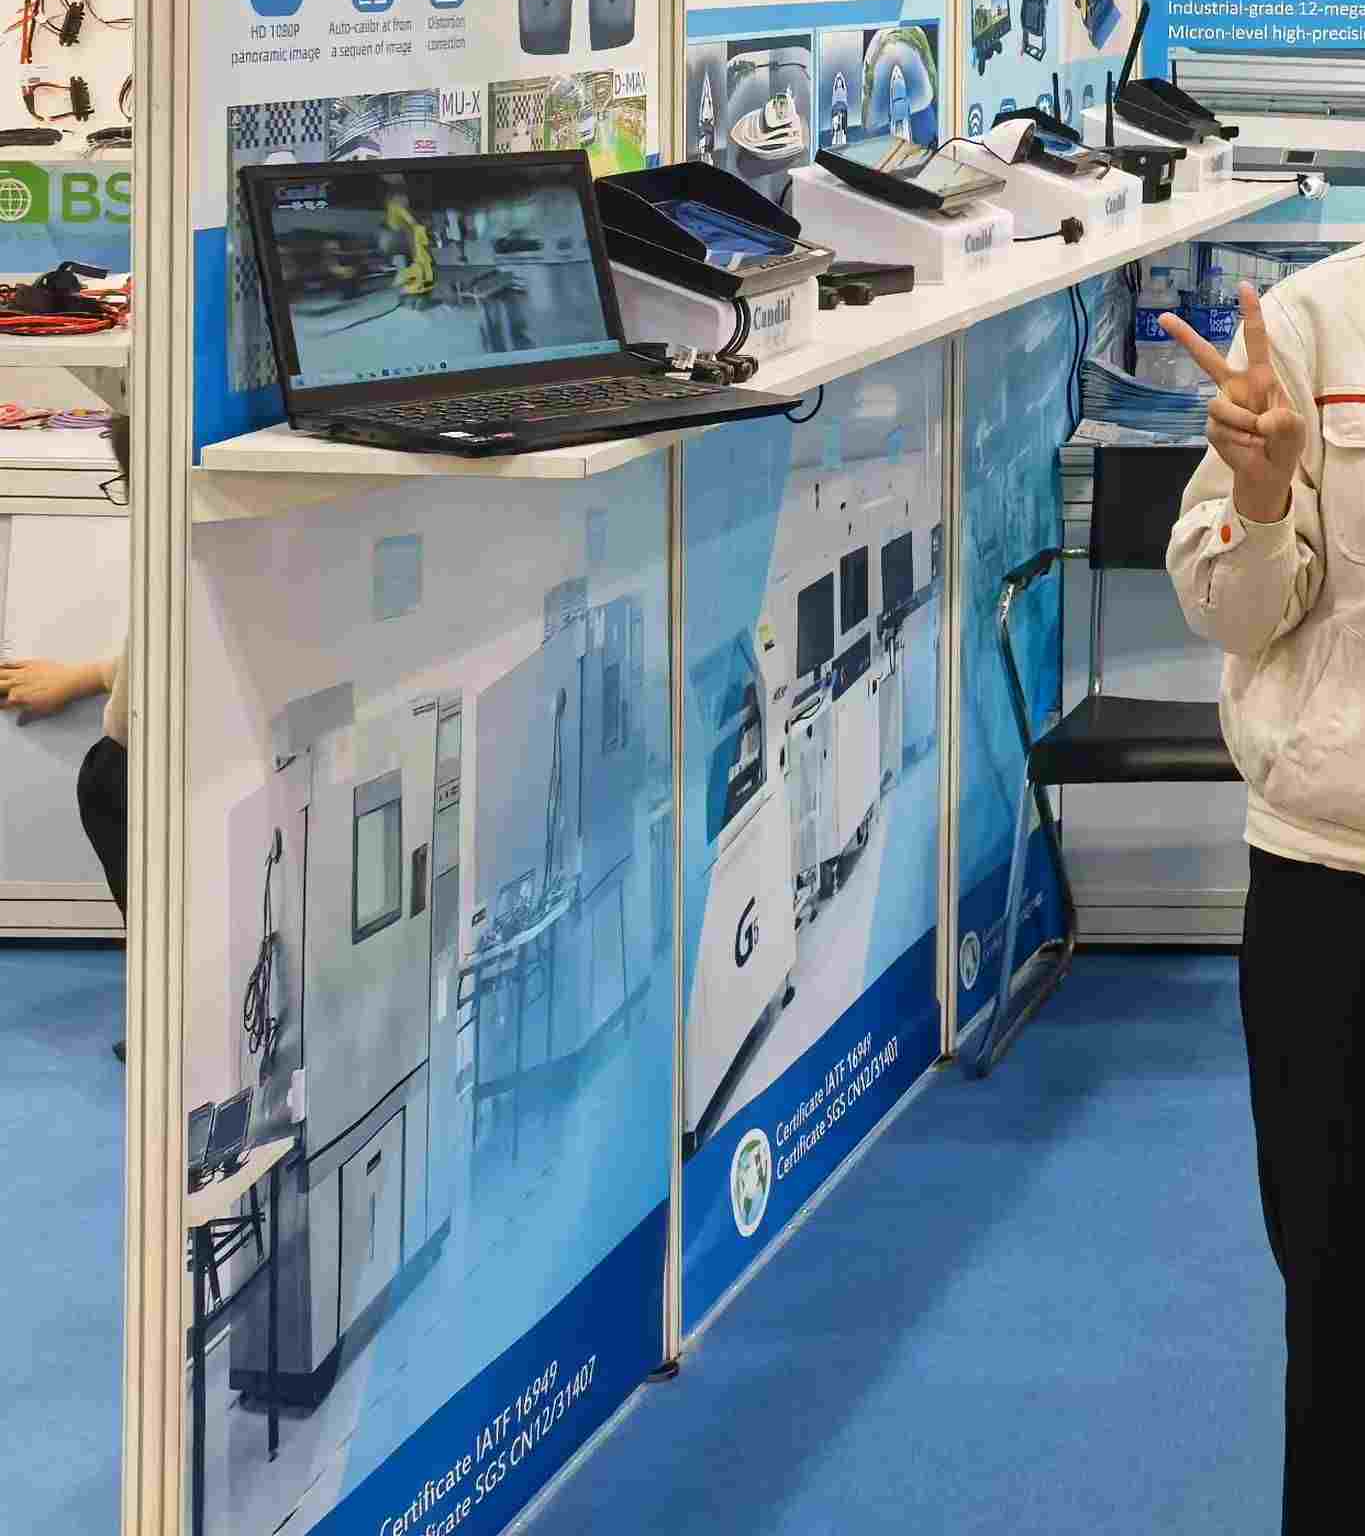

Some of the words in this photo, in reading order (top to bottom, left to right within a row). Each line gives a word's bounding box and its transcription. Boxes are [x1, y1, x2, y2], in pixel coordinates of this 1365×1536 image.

[1167, 0, 1294, 19] Industrial-grade
[1167, 25, 1269, 41] Micron-level
[441, 88, 480, 116] MU-X
[824, 1059, 846, 1097] IATF
[475, 1406, 511, 1464] IATF
[515, 1360, 559, 1422] 16949
[475, 1453, 507, 1504] SGS
[510, 1354, 597, 1467] CN12/31407
